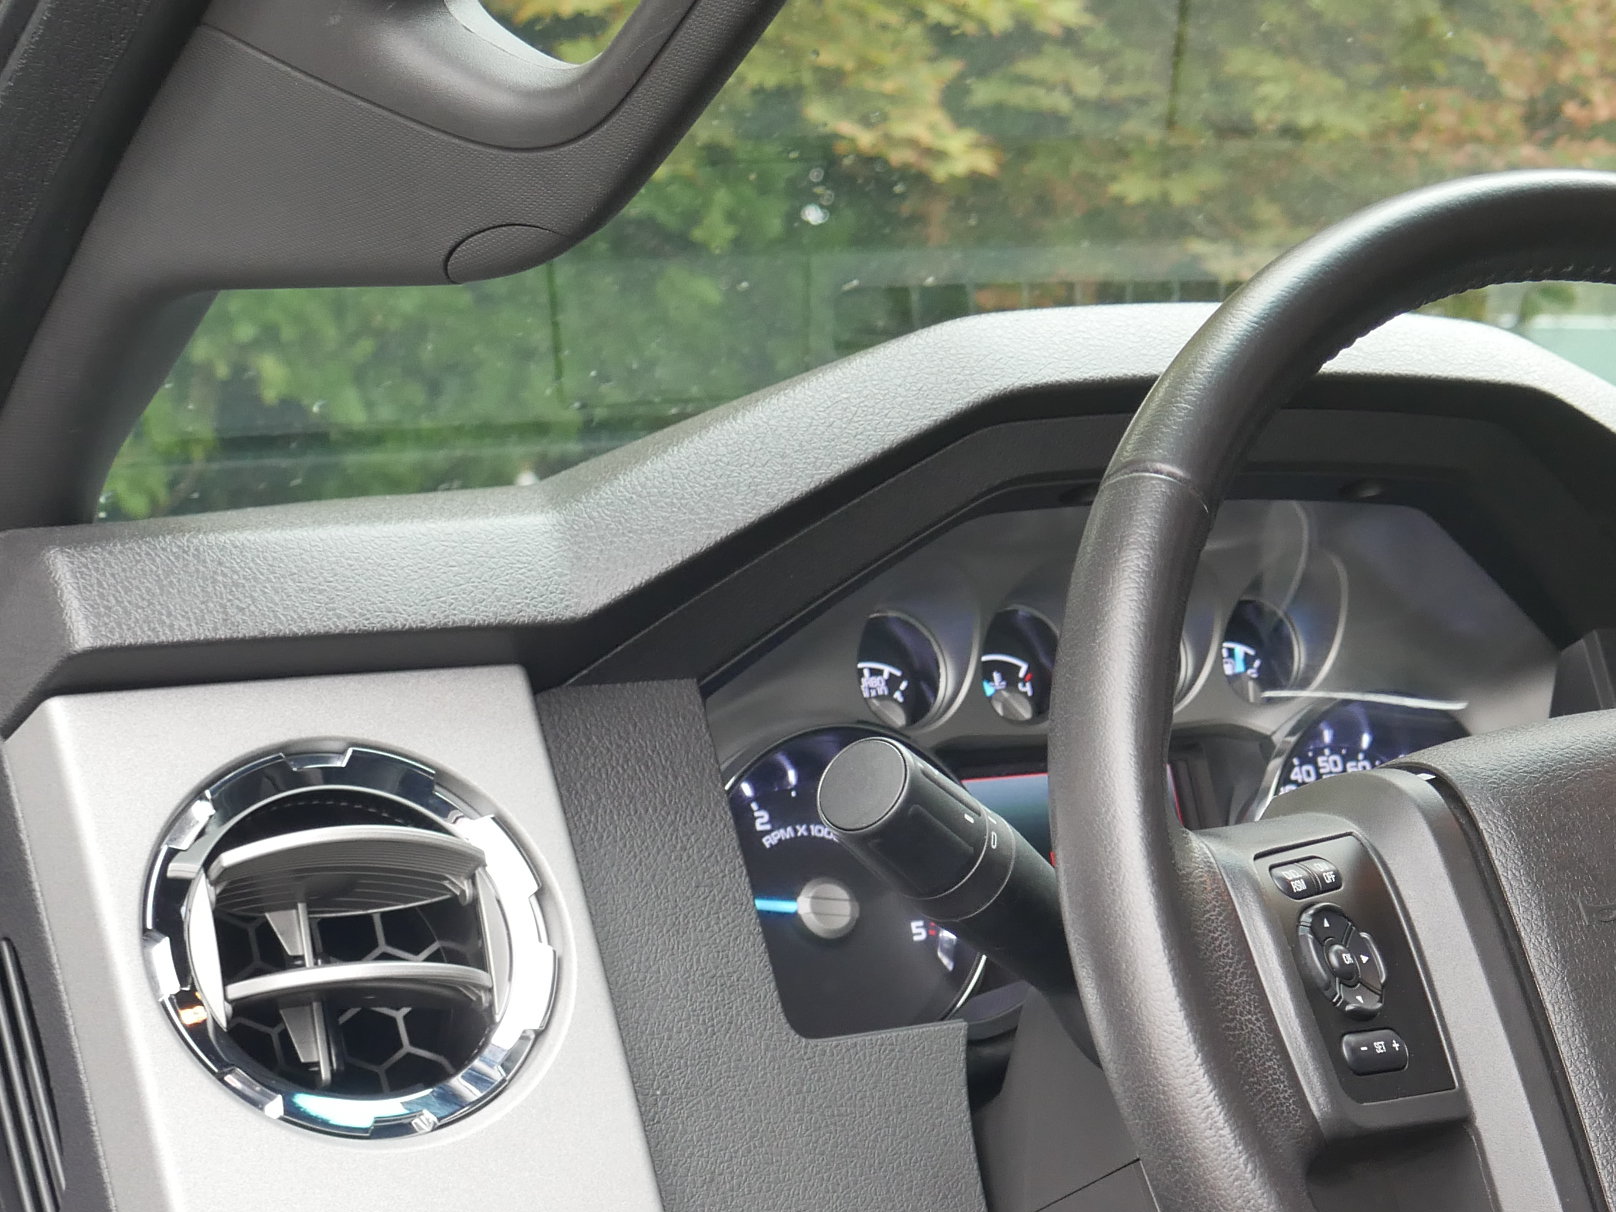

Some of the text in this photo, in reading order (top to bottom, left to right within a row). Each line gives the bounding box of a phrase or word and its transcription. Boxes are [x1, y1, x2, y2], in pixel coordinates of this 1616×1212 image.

[1290, 765, 1316, 783] 40
[1317, 755, 1344, 773] 50
[754, 809, 772, 831] 2
[761, 826, 795, 849] RPM
[1322, 871, 1336, 884] OFF
[910, 920, 928, 941] 5
[1373, 1041, 1386, 1054] SET
